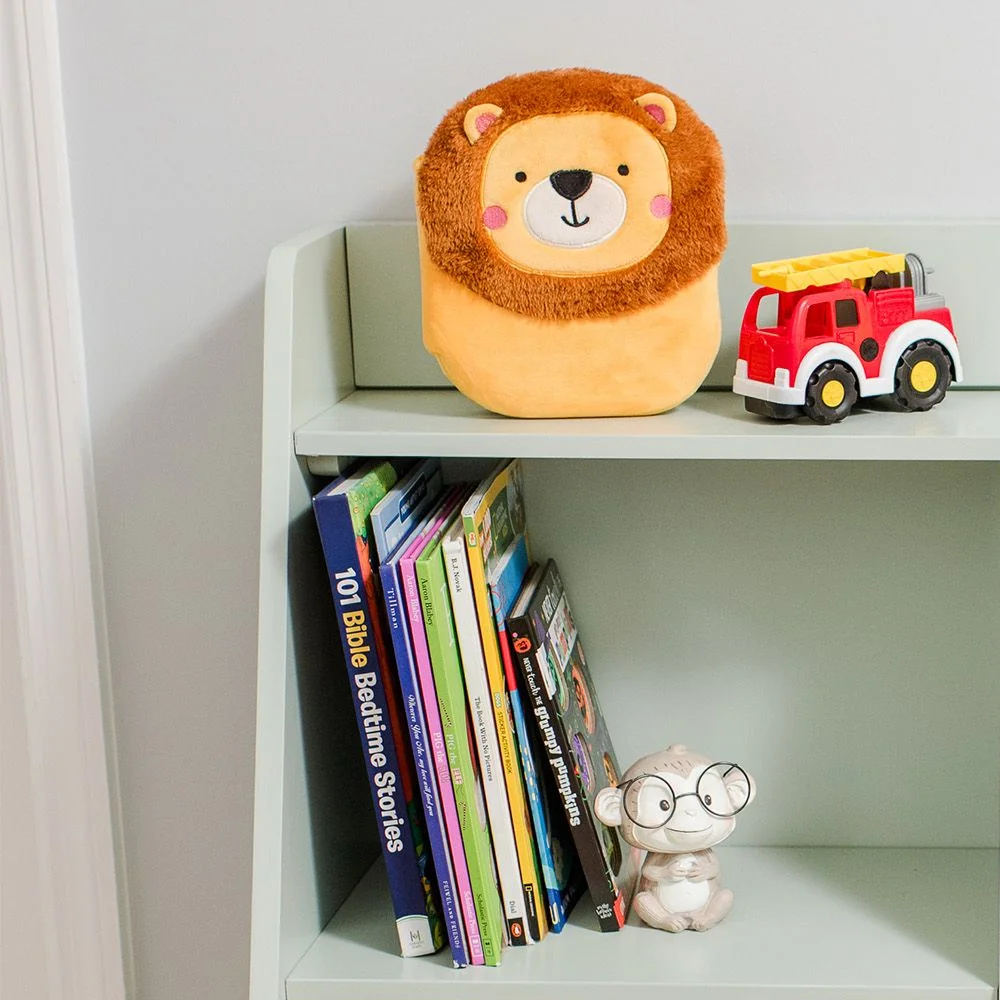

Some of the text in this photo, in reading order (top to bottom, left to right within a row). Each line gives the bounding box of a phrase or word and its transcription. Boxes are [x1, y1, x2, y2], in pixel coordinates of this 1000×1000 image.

[451, 558, 462, 593] B.J. Novak
[386, 588, 398, 629] Tillman
[425, 602, 434, 625] Blabey
[335, 567, 404, 853] 101 Bible Bedtime Stories
[477, 710, 485, 727] Book
[411, 723, 421, 740] You
[433, 732, 443, 748] PIG
[446, 734, 455, 749] PIG
[480, 726, 488, 745] With
[498, 711, 506, 734] STICKER
[502, 734, 510, 758] ACTIVITY
[523, 657, 581, 827] NEVER touch THE grumpy pumpkins
[436, 748, 444, 764] the
[450, 750, 459, 765] the
[482, 744, 489, 754] No
[484, 754, 493, 782] Pictures
[442, 880, 452, 906] FEIWEL
[451, 920, 460, 948] FRIENDS
[477, 894, 486, 920] Scholastic
[509, 900, 517, 913] Dial
